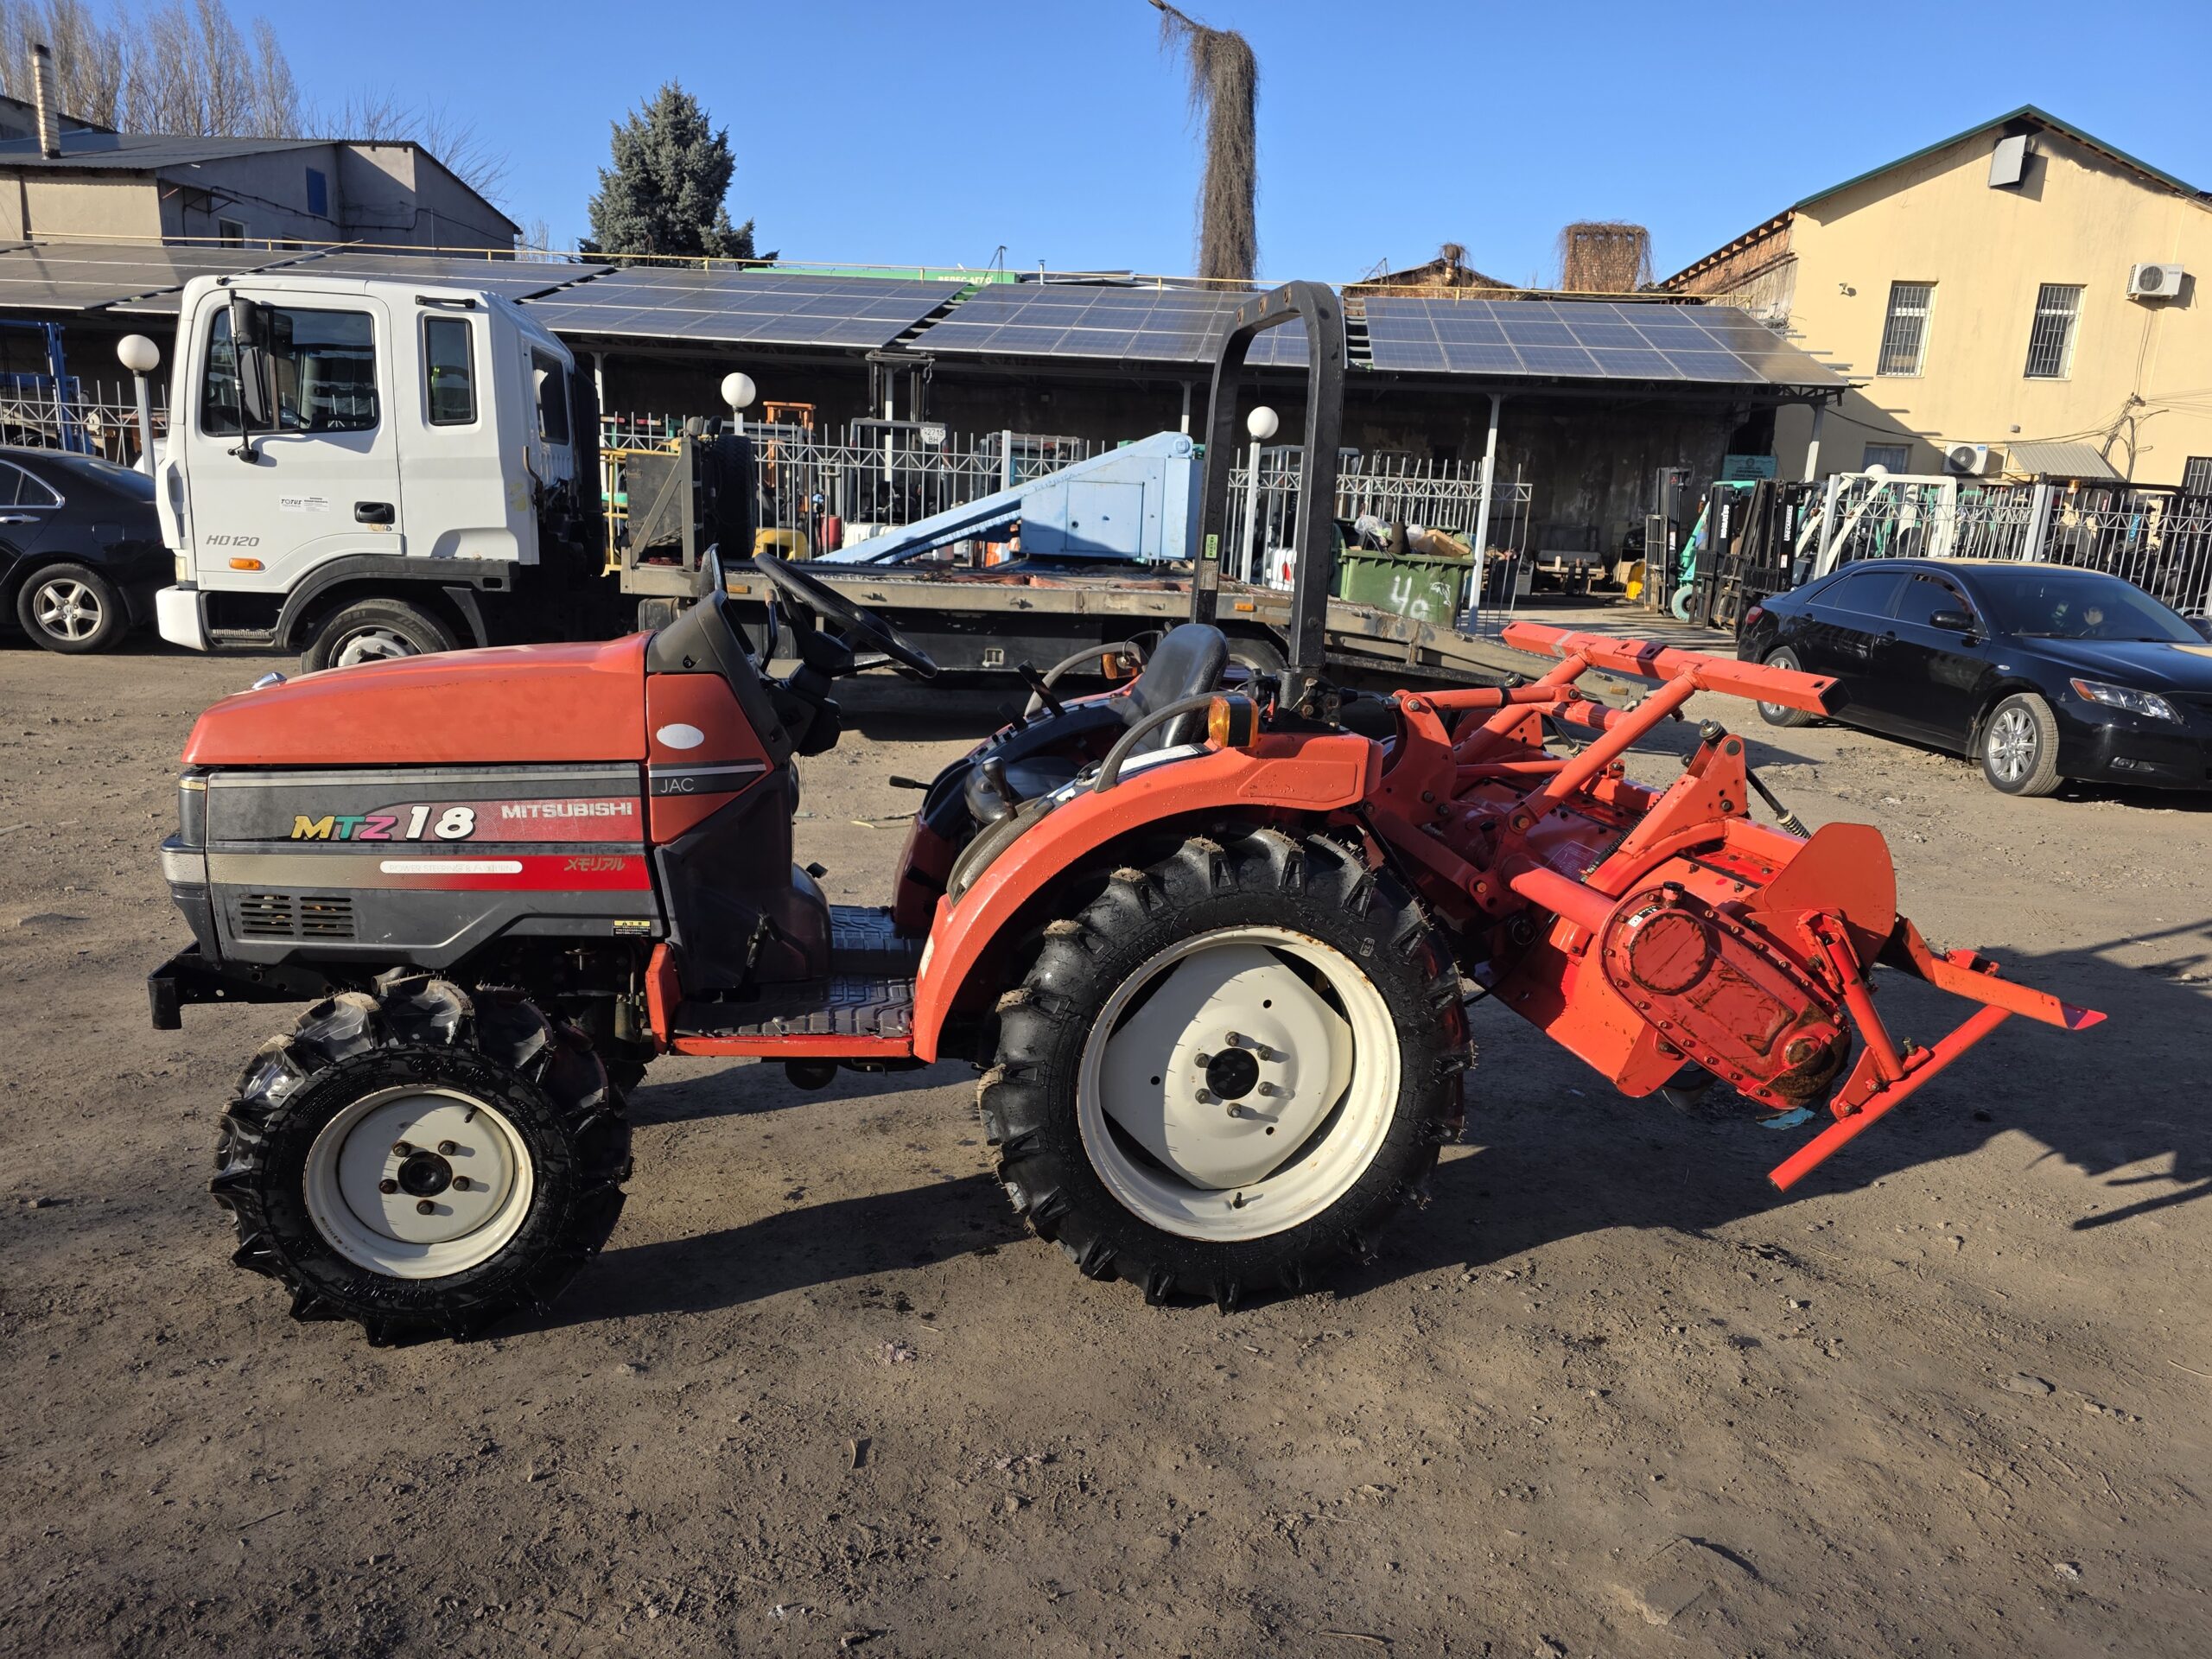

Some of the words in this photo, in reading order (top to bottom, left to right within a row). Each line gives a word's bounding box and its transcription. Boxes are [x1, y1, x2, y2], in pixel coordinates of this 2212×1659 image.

[1720, 505, 1729, 538] KOMATSU
[660, 778, 695, 793] JAC
[501, 802, 632, 819] MITSUBISHI
[563, 857, 626, 872] メモリアル
